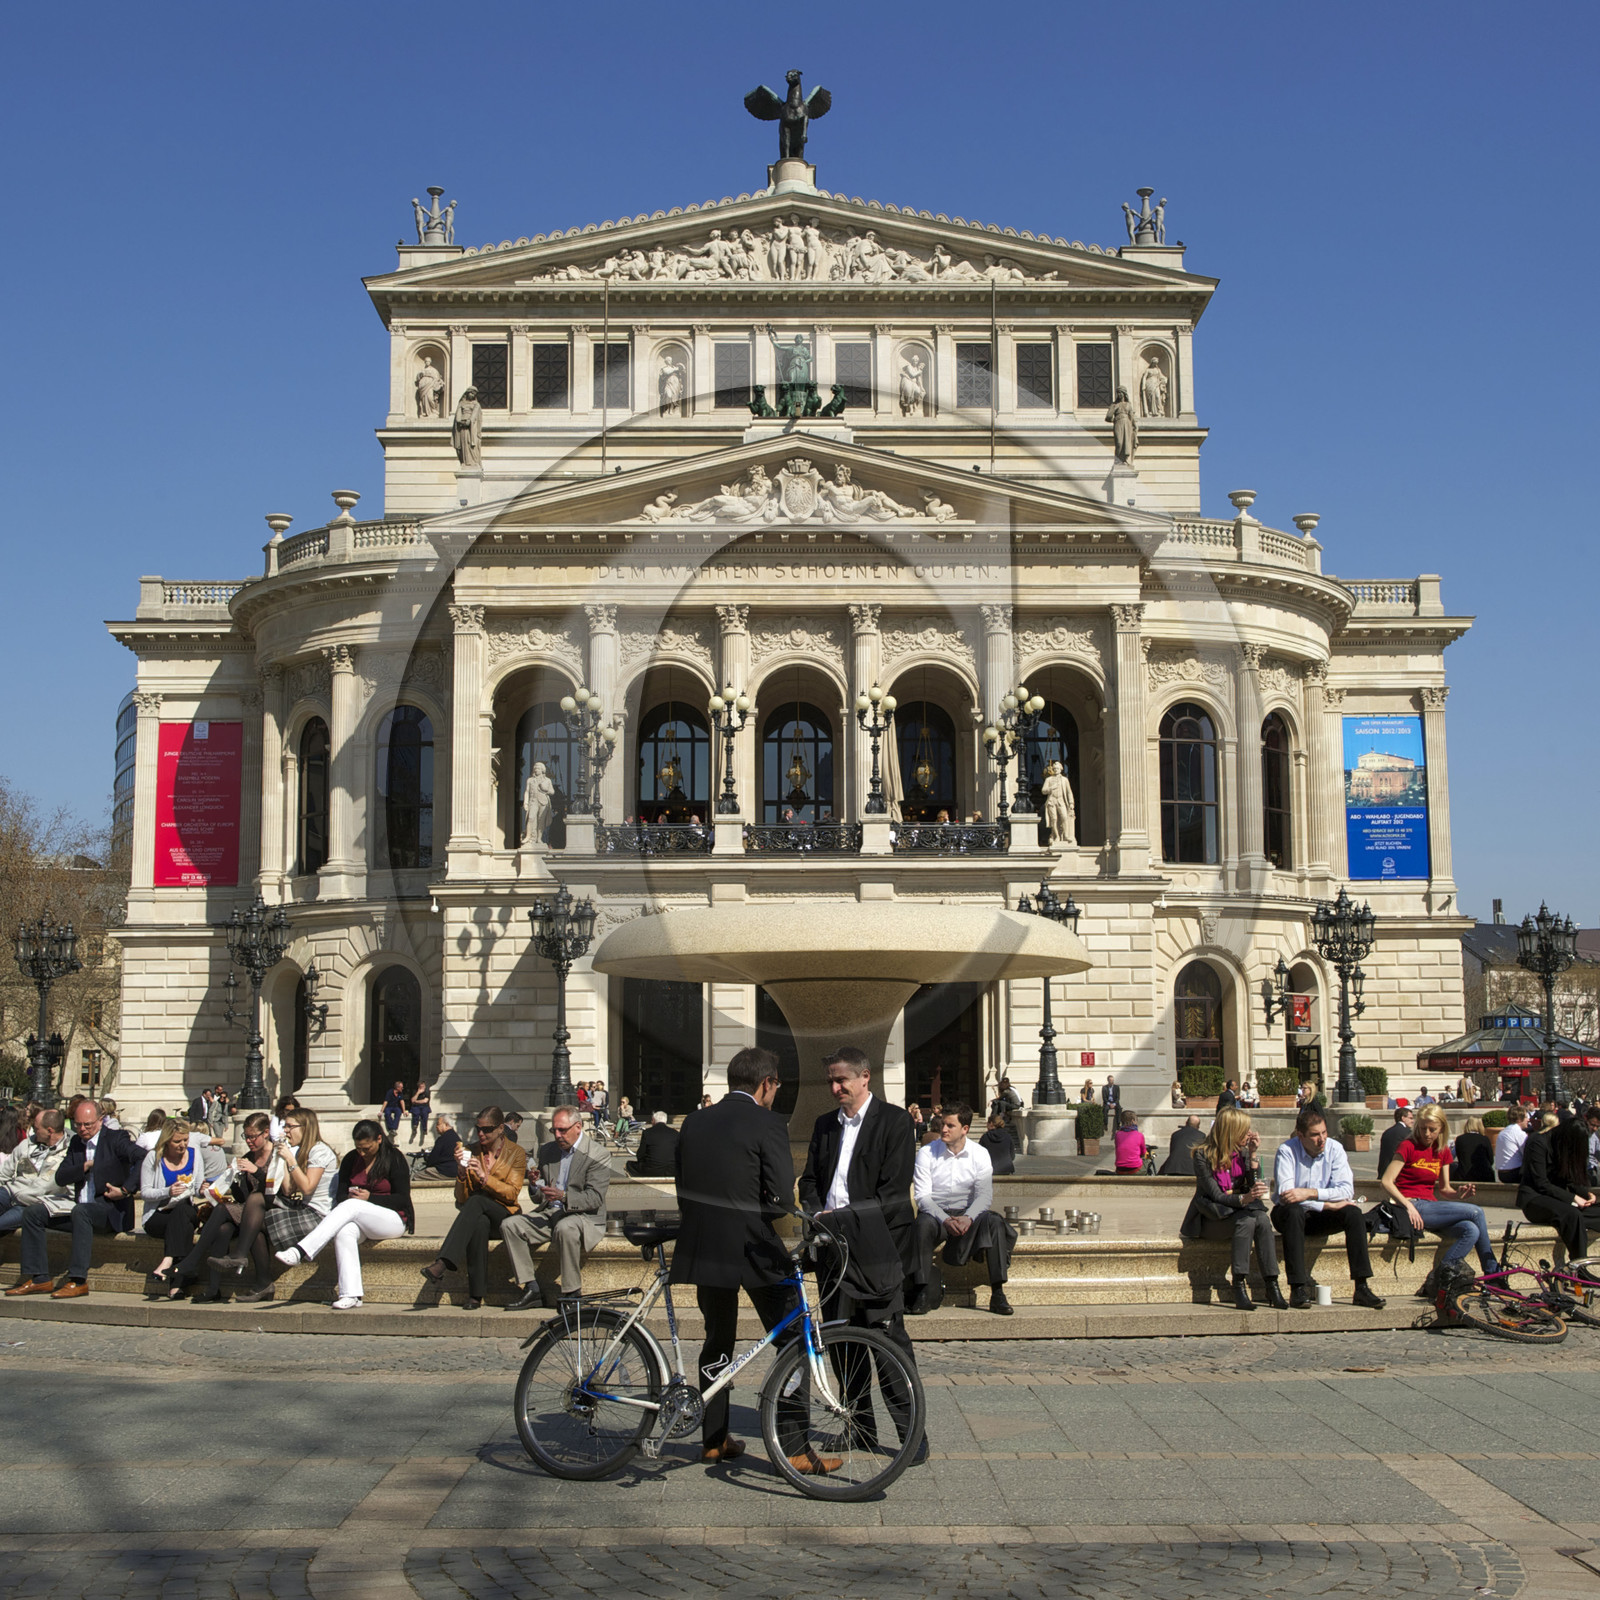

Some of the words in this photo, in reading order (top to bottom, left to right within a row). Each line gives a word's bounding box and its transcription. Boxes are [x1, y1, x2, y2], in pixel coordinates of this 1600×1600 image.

[598, 562, 646, 579] DEM
[659, 562, 759, 579] WAHREN
[774, 562, 899, 579] SCHOENEN
[730, 1337, 765, 1373] BENOTTO
